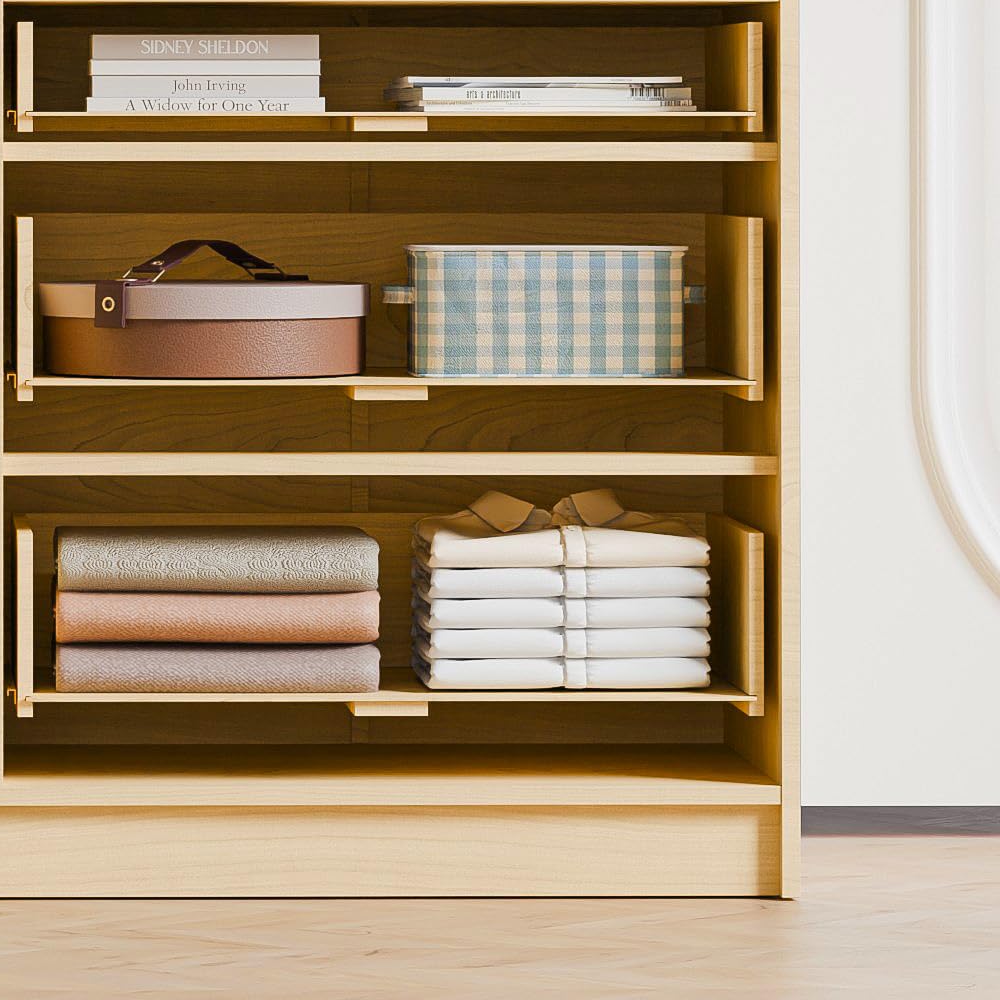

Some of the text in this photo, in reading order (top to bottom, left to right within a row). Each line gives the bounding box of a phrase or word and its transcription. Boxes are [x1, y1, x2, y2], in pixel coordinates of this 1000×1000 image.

[140, 39, 269, 55] SIDNEY SHELDON
[171, 79, 247, 95] John Irving
[486, 89, 521, 99] architecture
[125, 97, 290, 112] A Widow for One Year
